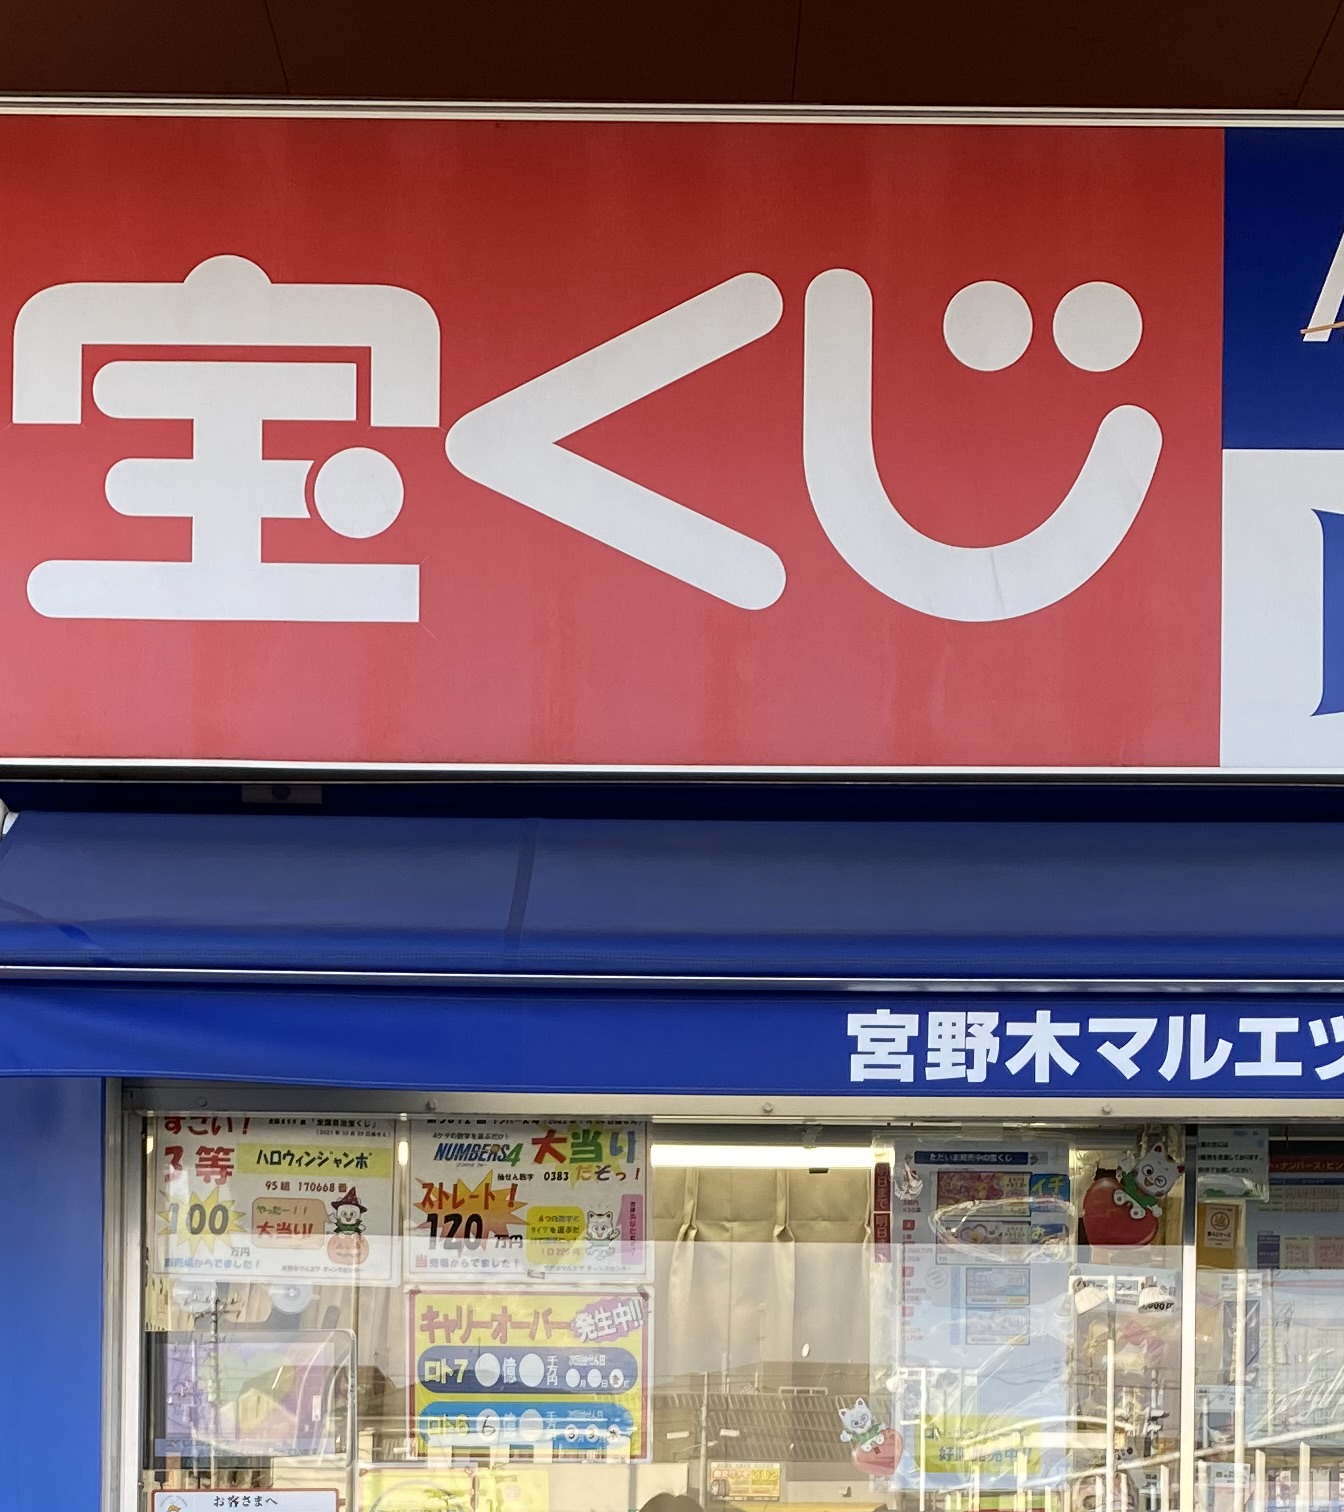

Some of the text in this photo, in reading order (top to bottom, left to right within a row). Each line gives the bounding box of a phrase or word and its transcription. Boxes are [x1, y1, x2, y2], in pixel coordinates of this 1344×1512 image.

[14, 255, 1161, 621] 宝くじ
[256, 1150, 372, 1169] ハロウィンジャンボ
[532, 1129, 636, 1164] 大当り
[544, 1172, 569, 1181] 0383
[427, 1214, 483, 1250] 120
[494, 1234, 523, 1249] 万円
[420, 1305, 572, 1344] キャリーオーバー
[424, 1358, 468, 1384] ロト7
[214, 1495, 278, 1507] お客さまへ
